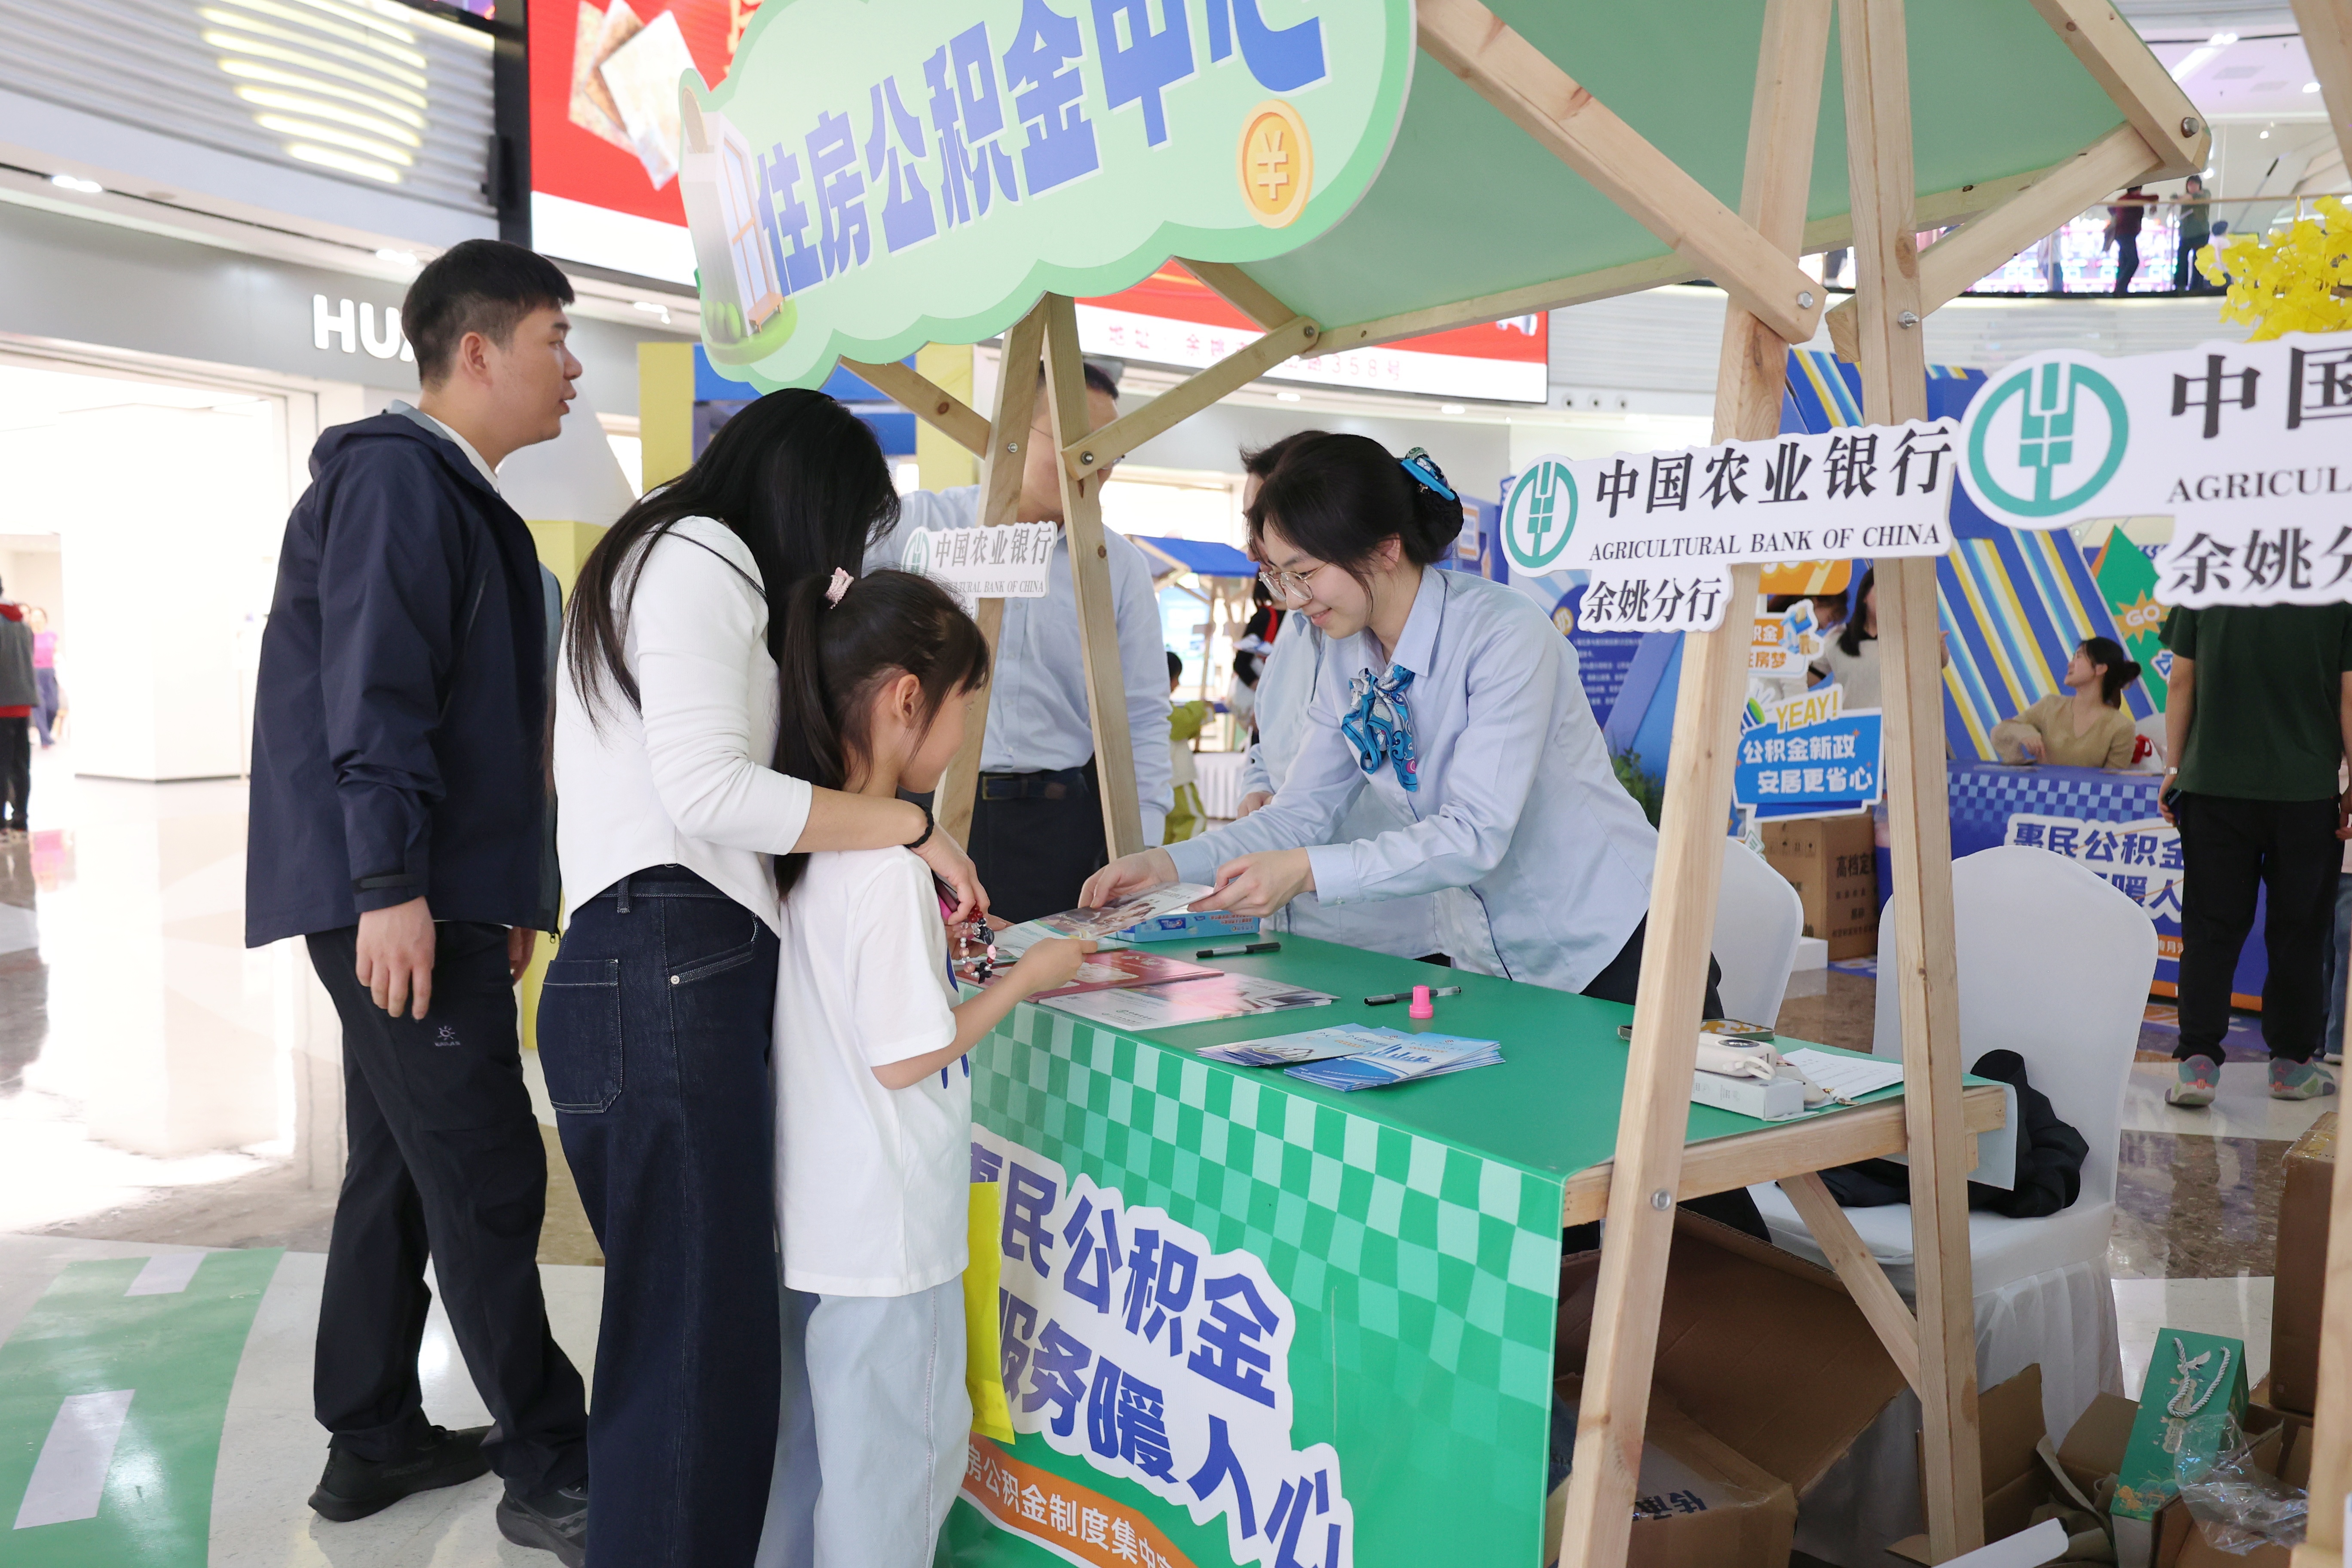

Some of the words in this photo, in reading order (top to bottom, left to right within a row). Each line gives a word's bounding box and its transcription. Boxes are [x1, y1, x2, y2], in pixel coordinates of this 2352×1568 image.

[313, 294, 414, 362] HU
[1596, 426, 1952, 518] 中国农业银行
[2167, 466, 2352, 503] AGRICUL
[935, 527, 1052, 568] 中国农业银行
[1589, 534, 1741, 561] AGRICULTURAL
[1750, 530, 1813, 553] BANK
[1822, 528, 1854, 550] OF
[1862, 523, 1941, 547] CHINA
[984, 581, 1005, 593] BANK
[1007, 580, 1018, 593] OF
[1019, 580, 1044, 593] CHINA
[1584, 577, 1722, 624] 余姚分行
[2126, 605, 2160, 627] GO
[1776, 690, 1838, 731] YEAY!
[1743, 734, 1856, 764] 公积金新政
[1758, 766, 1873, 794] 安居更省心
